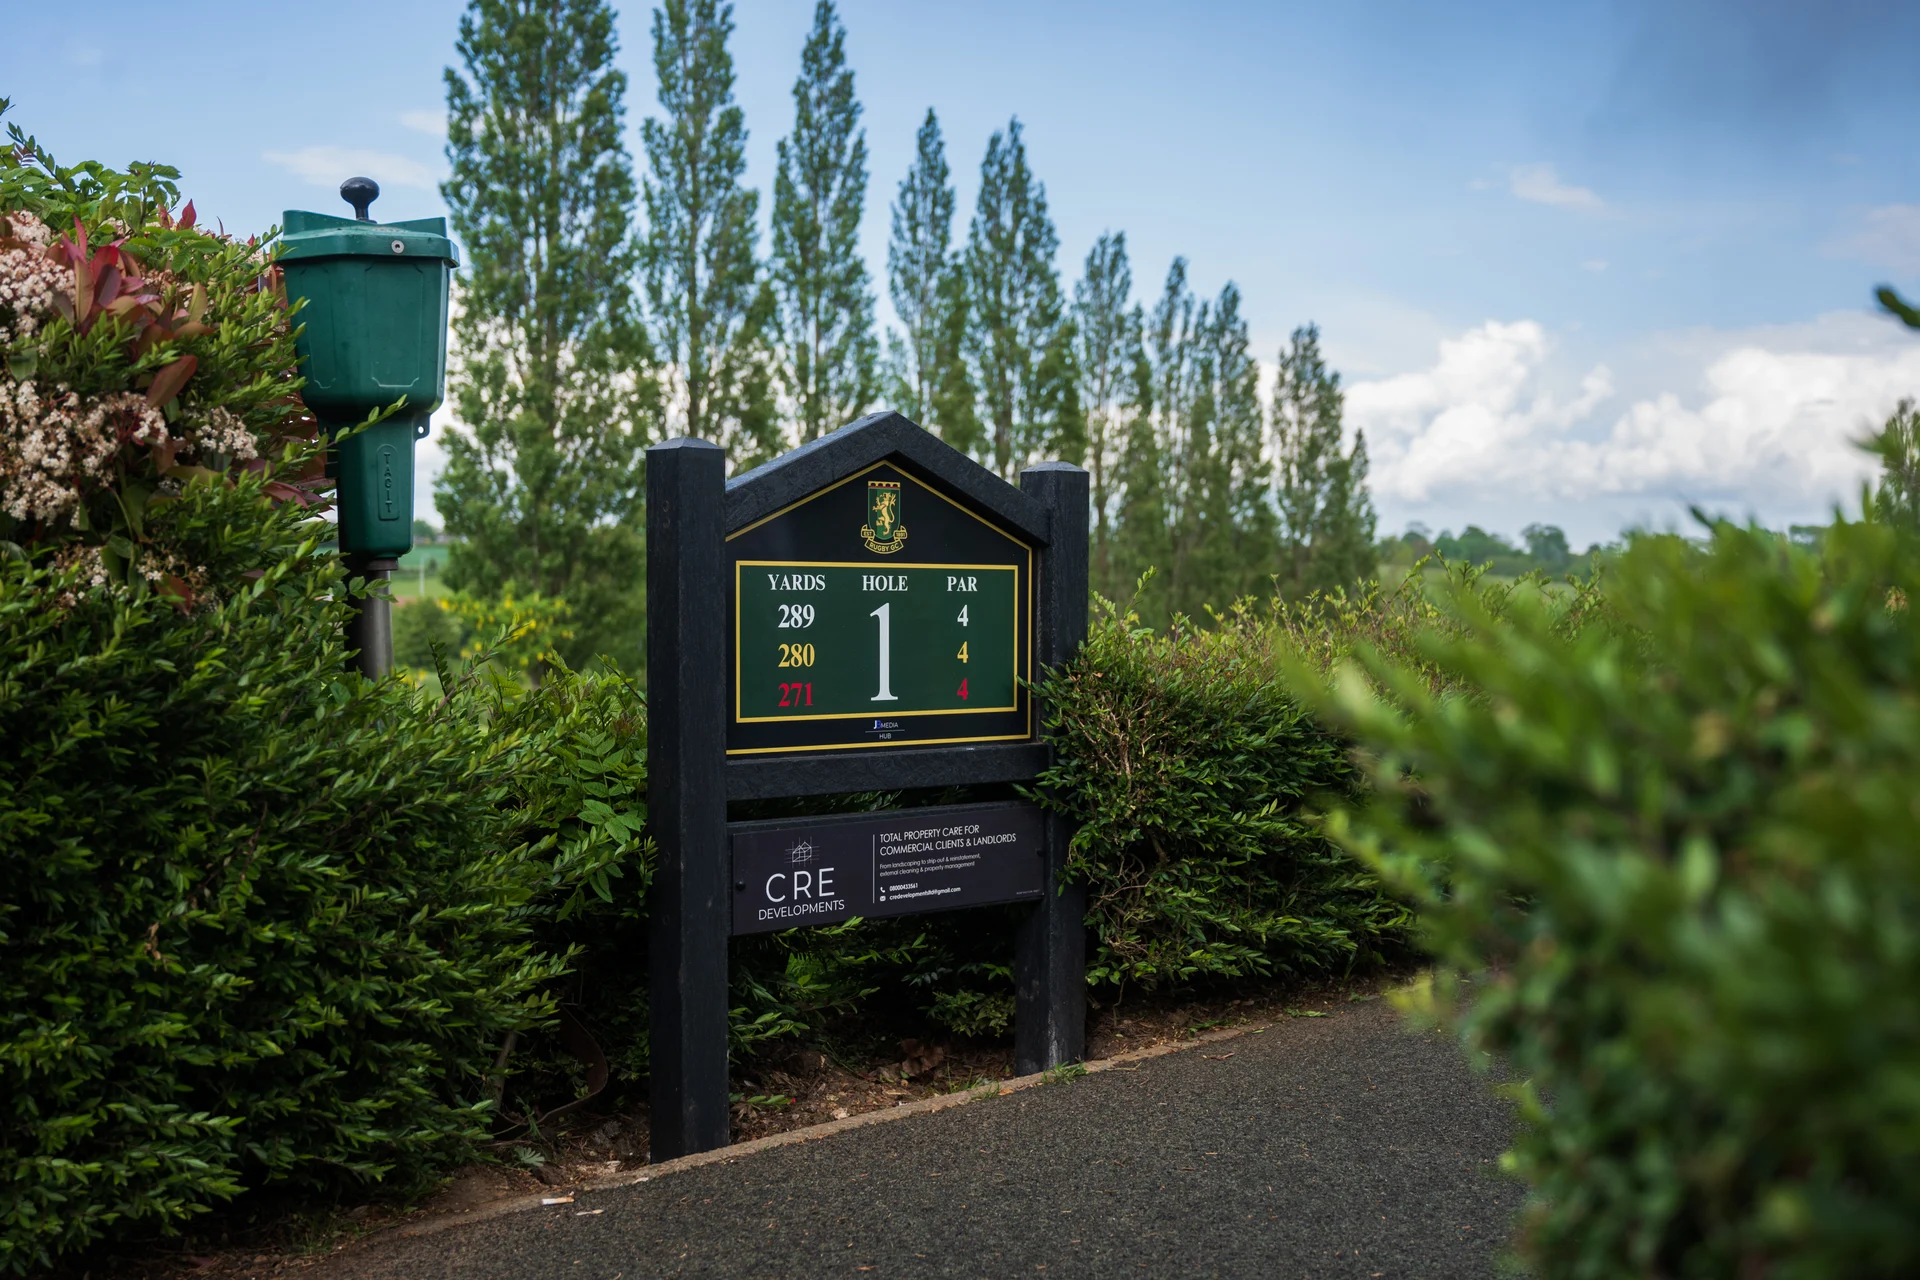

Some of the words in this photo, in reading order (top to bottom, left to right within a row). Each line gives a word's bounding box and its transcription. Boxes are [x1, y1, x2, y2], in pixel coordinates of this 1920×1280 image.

[384, 452, 392, 513] TACIT
[869, 542, 889, 552] RUGBY
[767, 574, 826, 591] YARDS
[862, 575, 908, 591] HOLE
[947, 576, 978, 592] PAR
[778, 604, 815, 628] 289
[957, 604, 968, 627] 4
[778, 643, 815, 667] 280
[870, 602, 898, 701] 1
[957, 641, 968, 663] 4
[778, 682, 813, 707] 271
[957, 678, 968, 700] 4
[880, 832, 902, 842] TOTAL
[904, 828, 940, 840] PROPERTY
[942, 826, 963, 837] CARE
[964, 824, 980, 835] FOR
[880, 842, 934, 856] COMMERCIAL
[935, 838, 964, 850] CLIENTS
[966, 838, 972, 847] &
[973, 833, 1016, 846] LANDLORDS
[892, 860, 920, 868] landscaping
[900, 867, 920, 875] cleaning
[924, 864, 944, 872] property
[944, 861, 975, 870] management
[766, 867, 835, 902] CRE
[758, 900, 845, 920] DEVELOPMENTS
